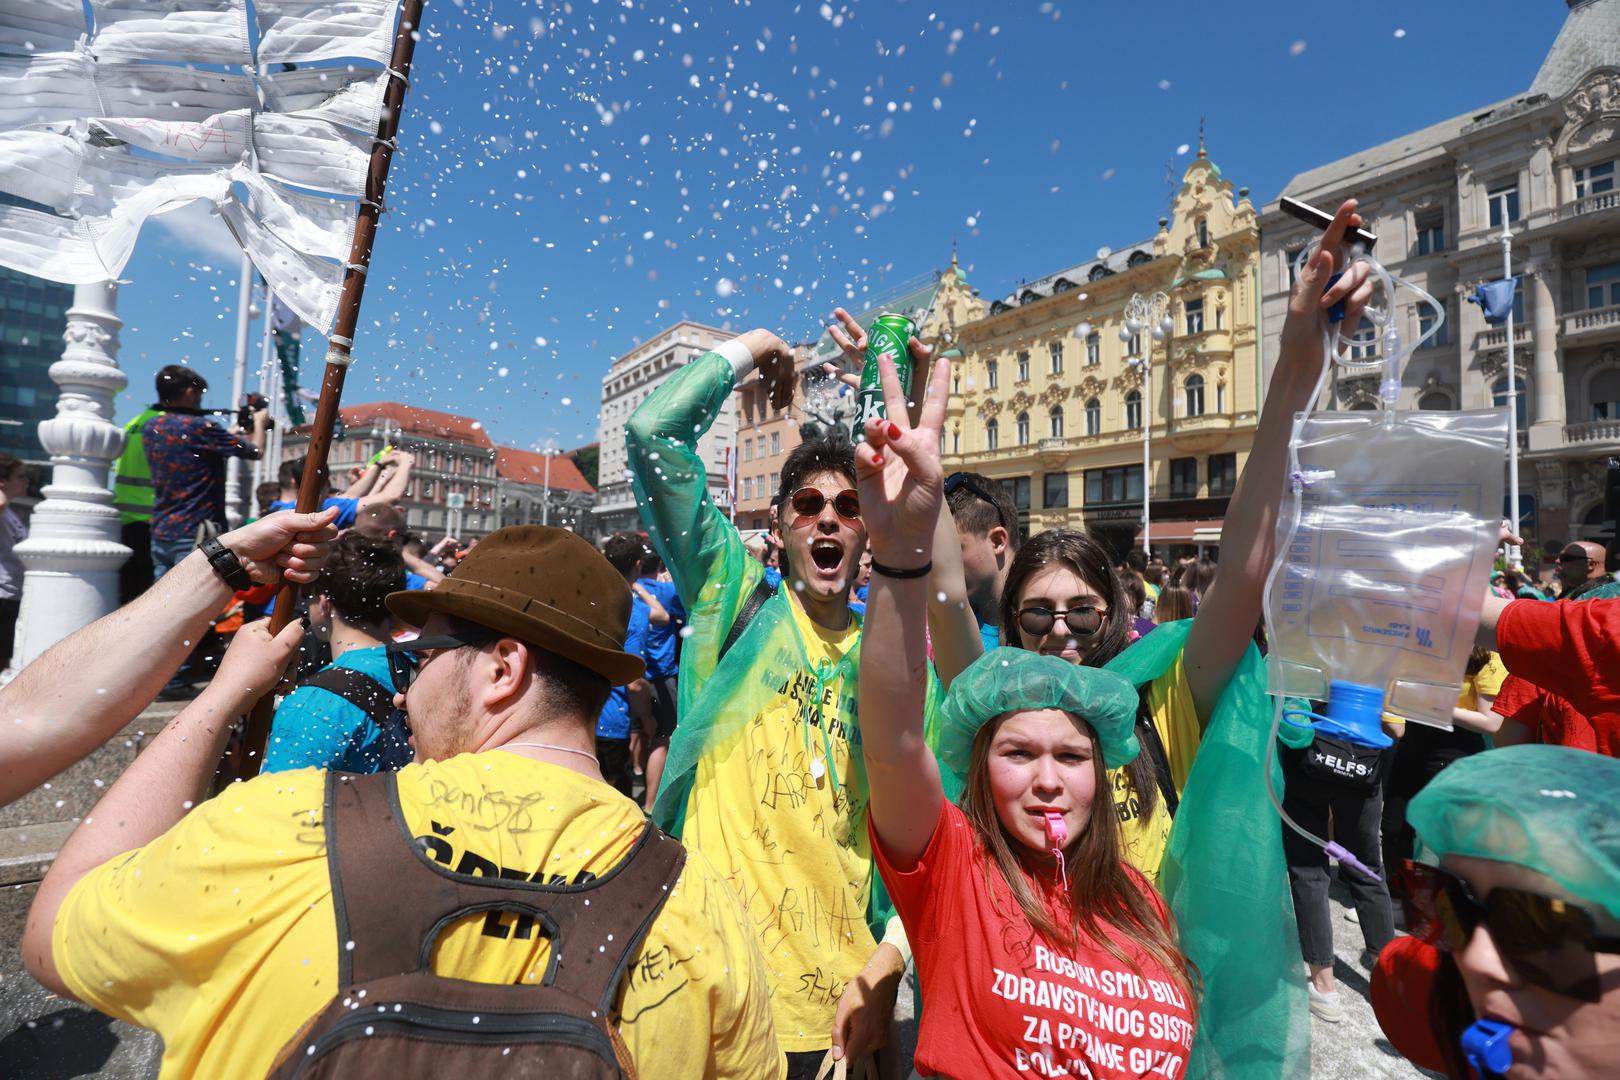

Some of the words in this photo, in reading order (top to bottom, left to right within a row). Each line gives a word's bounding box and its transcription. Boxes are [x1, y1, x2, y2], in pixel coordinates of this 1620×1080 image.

[1324, 754, 1367, 776] ELFS
[1101, 970, 1148, 999] SMO
[1023, 1015, 1053, 1045] ZA
